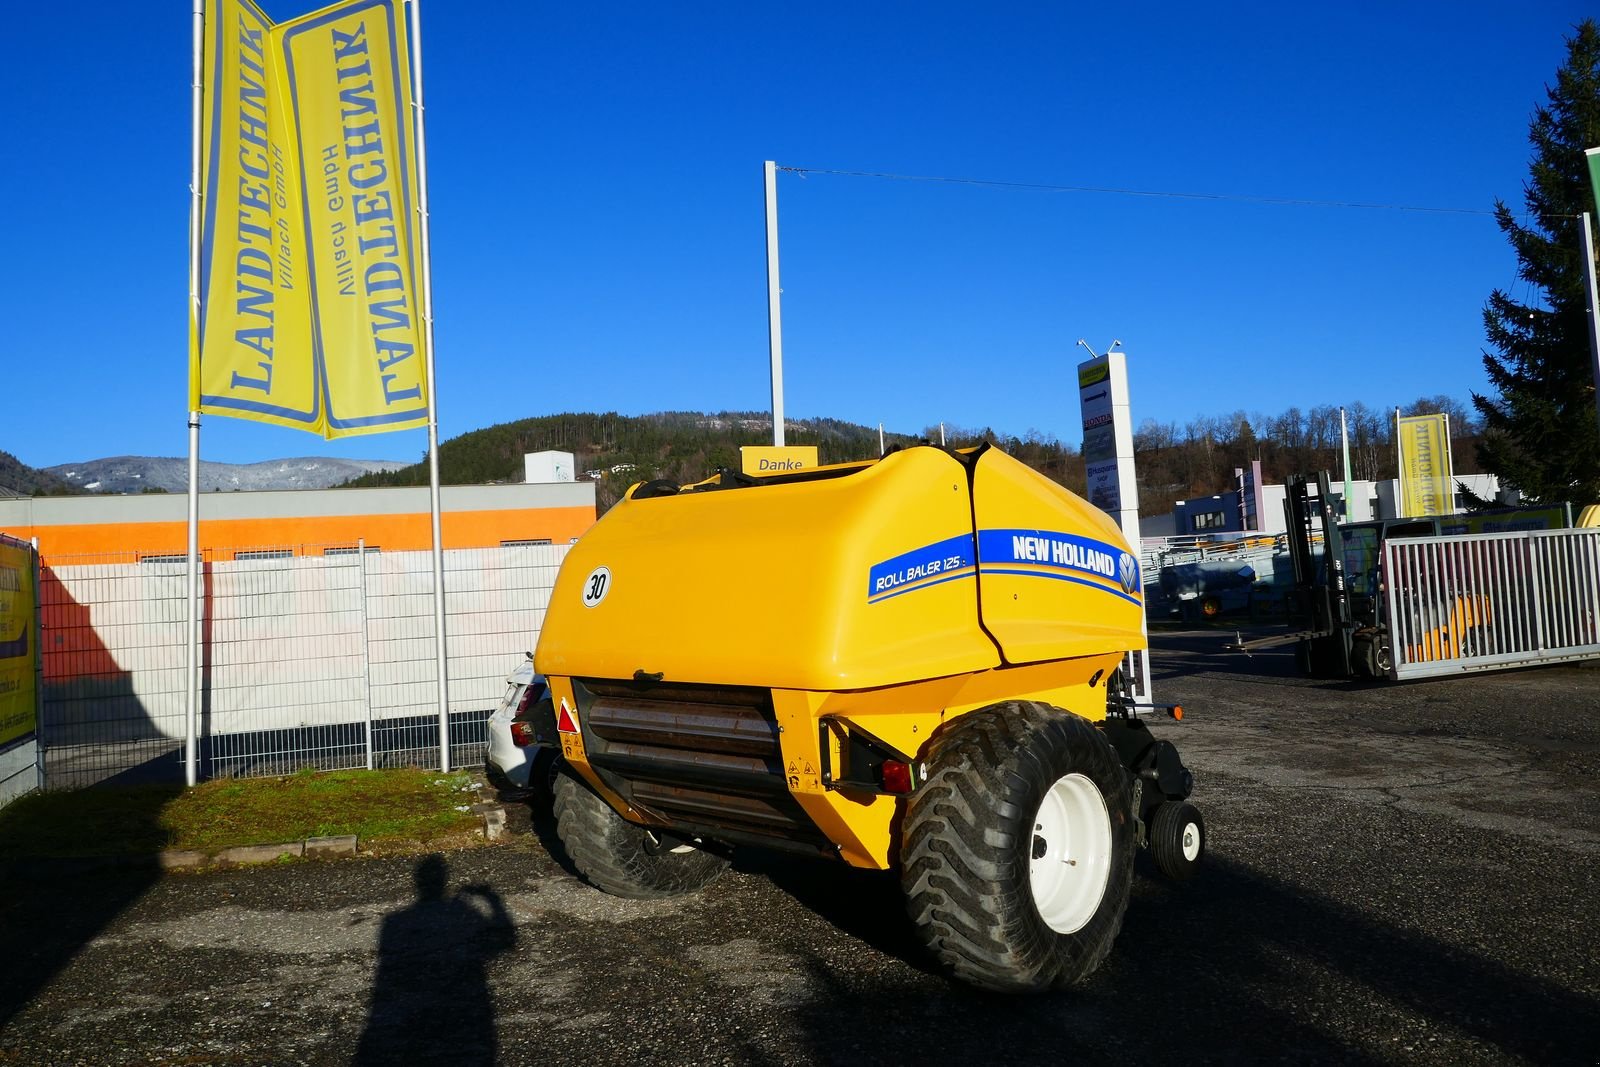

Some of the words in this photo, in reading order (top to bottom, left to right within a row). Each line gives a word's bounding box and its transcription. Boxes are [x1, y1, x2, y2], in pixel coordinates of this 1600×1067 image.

[271, 145, 288, 210] GmbH
[230, 13, 275, 395] LANDTECHNIK
[275, 217, 294, 290] Villach
[1084, 413, 1113, 427] HONDA
[759, 458, 802, 471] Danke
[876, 572, 906, 592] ROLL
[906, 561, 941, 581] BALER
[943, 556, 961, 570] 125
[1012, 535, 1050, 562] NEW
[1052, 539, 1115, 577] HOLLAND
[586, 573, 607, 600] 30
